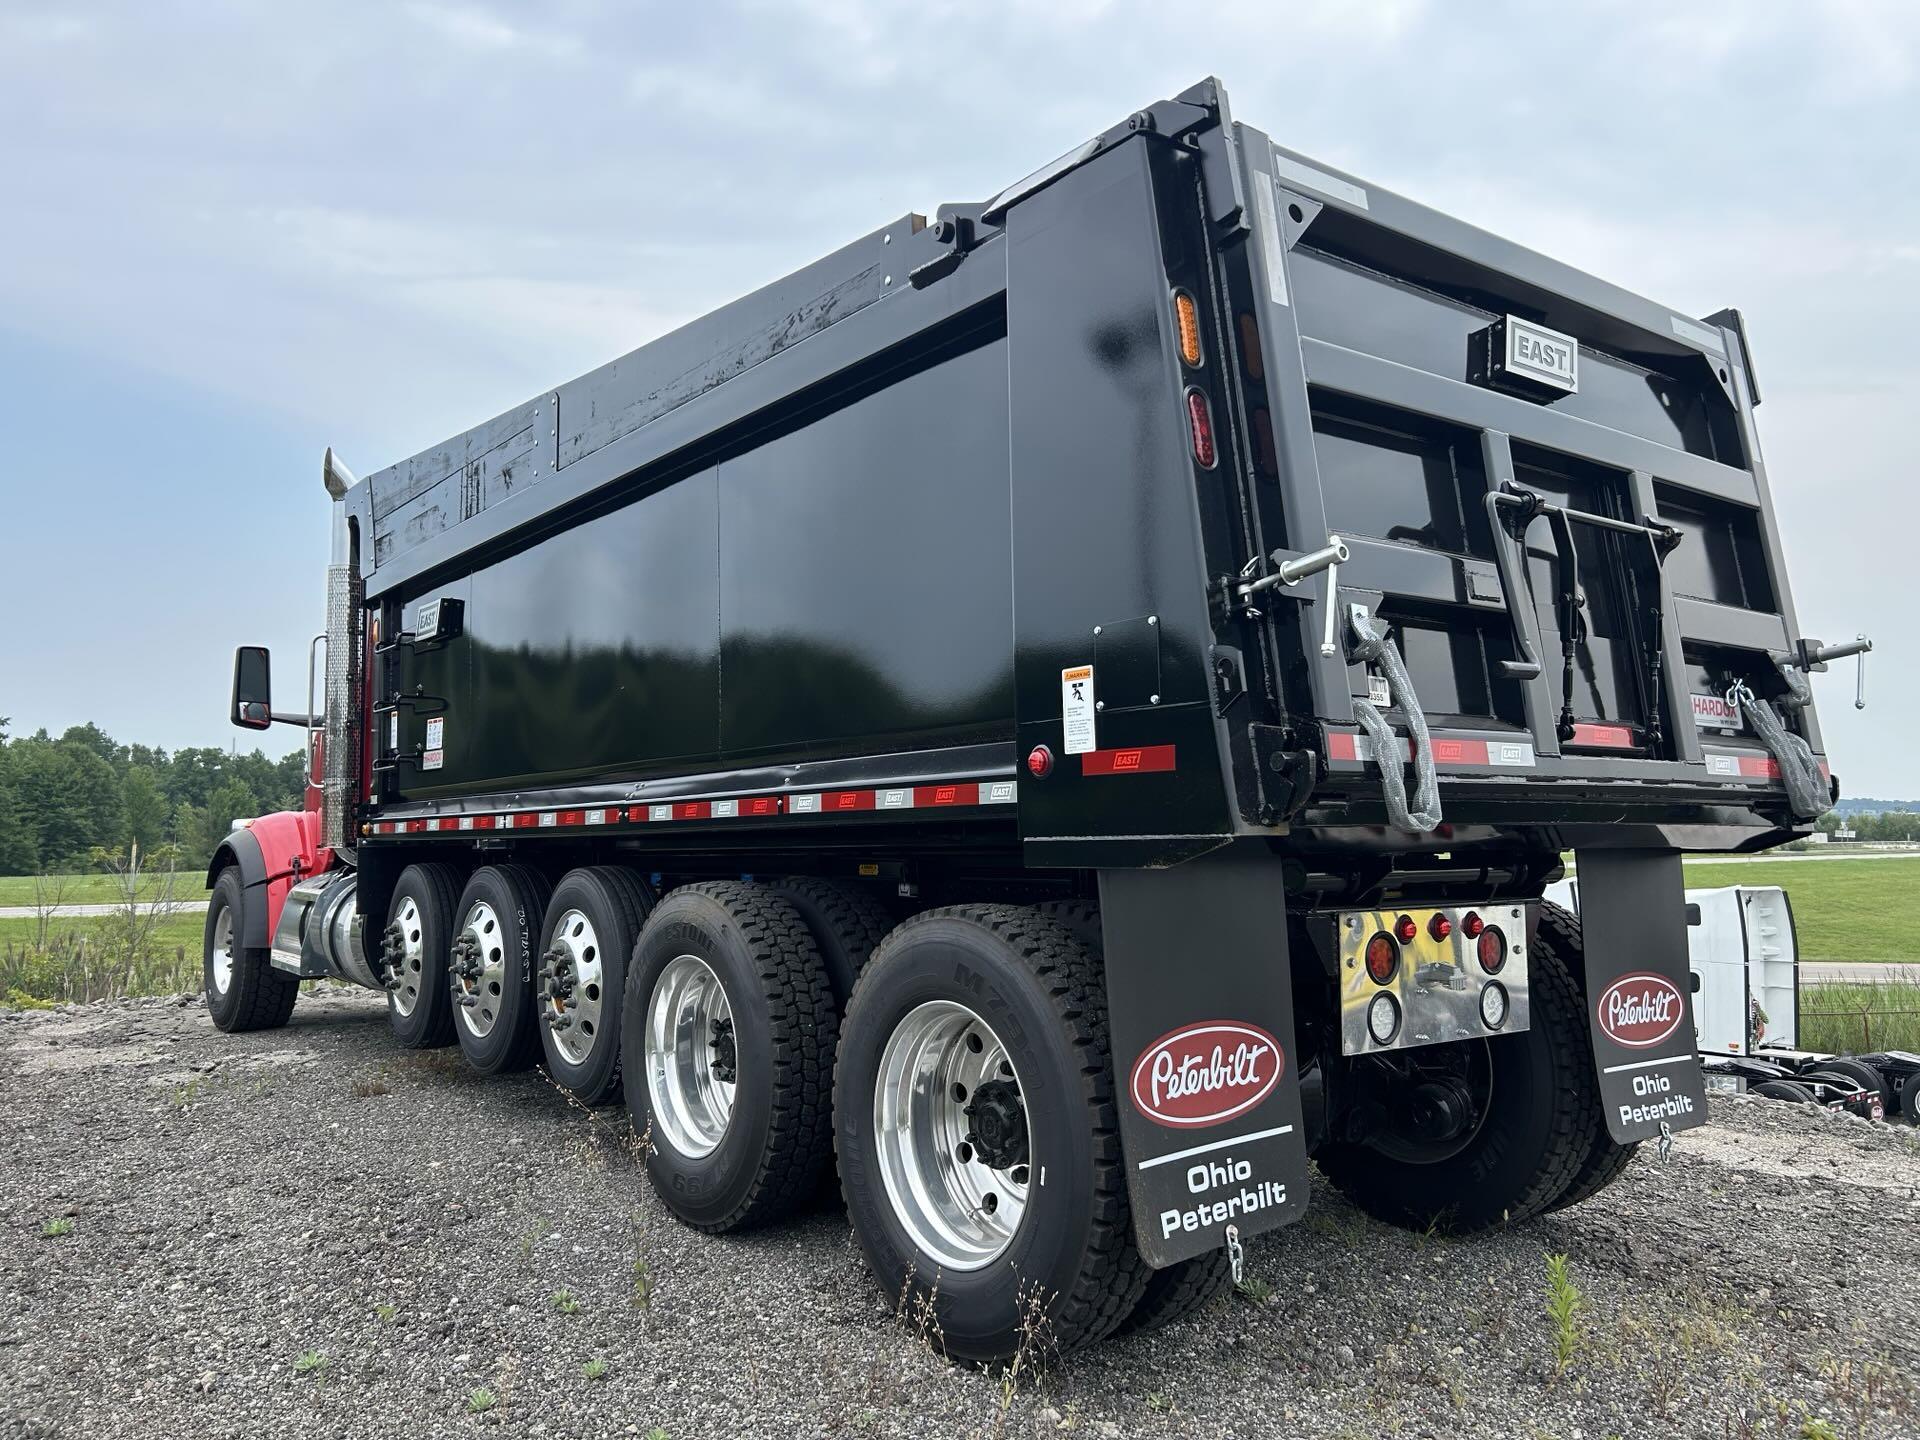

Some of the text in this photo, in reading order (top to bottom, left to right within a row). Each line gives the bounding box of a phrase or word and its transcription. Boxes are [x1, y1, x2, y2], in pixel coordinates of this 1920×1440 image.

[1518, 335, 1567, 371] EAST
[420, 611, 437, 629] EAST
[1693, 697, 1737, 718] HARDOX
[1117, 755, 1138, 765] EAST
[1441, 746, 1459, 757] EAST
[1503, 749, 1520, 759] EAST
[993, 787, 1010, 797] EAST
[1608, 989, 1676, 1031] Peterbilt
[1151, 1042, 1269, 1108] Peterbilt
[1632, 1073, 1671, 1096] Ohio
[1618, 1095, 1694, 1126] Peterbilt
[1187, 1157, 1252, 1194] Ohio
[1160, 1181, 1287, 1240] Peterbilt
